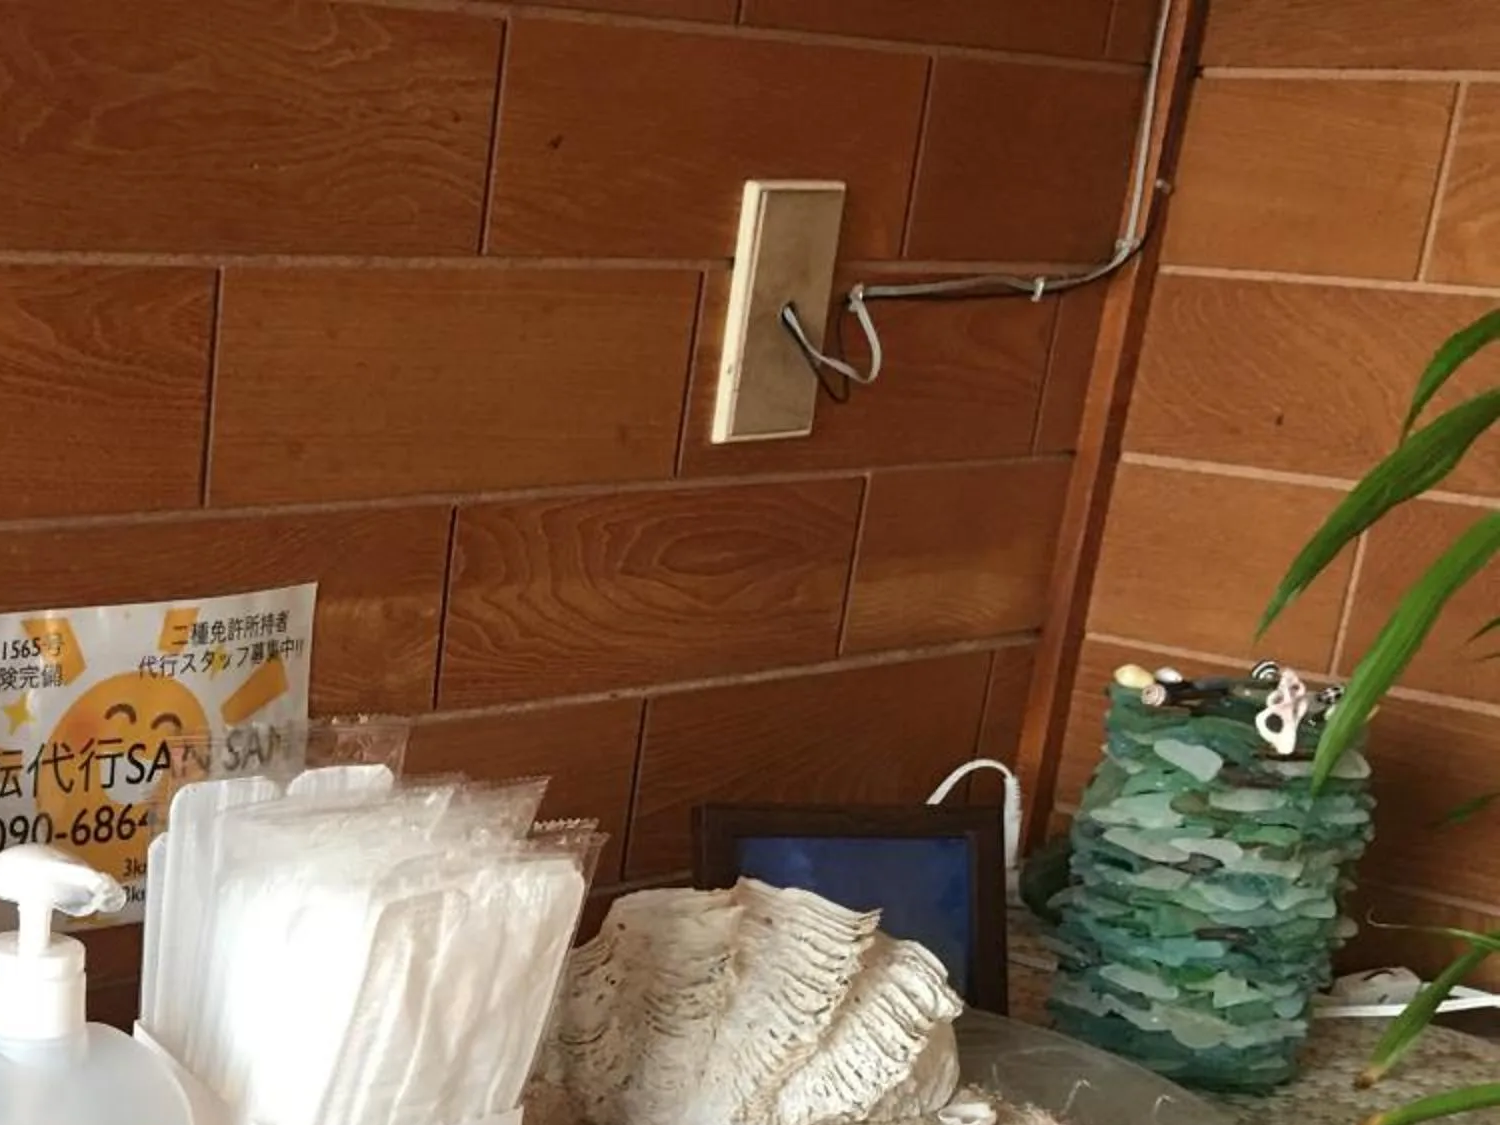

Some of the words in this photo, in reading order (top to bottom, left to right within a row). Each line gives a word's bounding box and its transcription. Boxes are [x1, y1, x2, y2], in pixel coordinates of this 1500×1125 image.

[171, 609, 291, 646] 二種免許所持者
